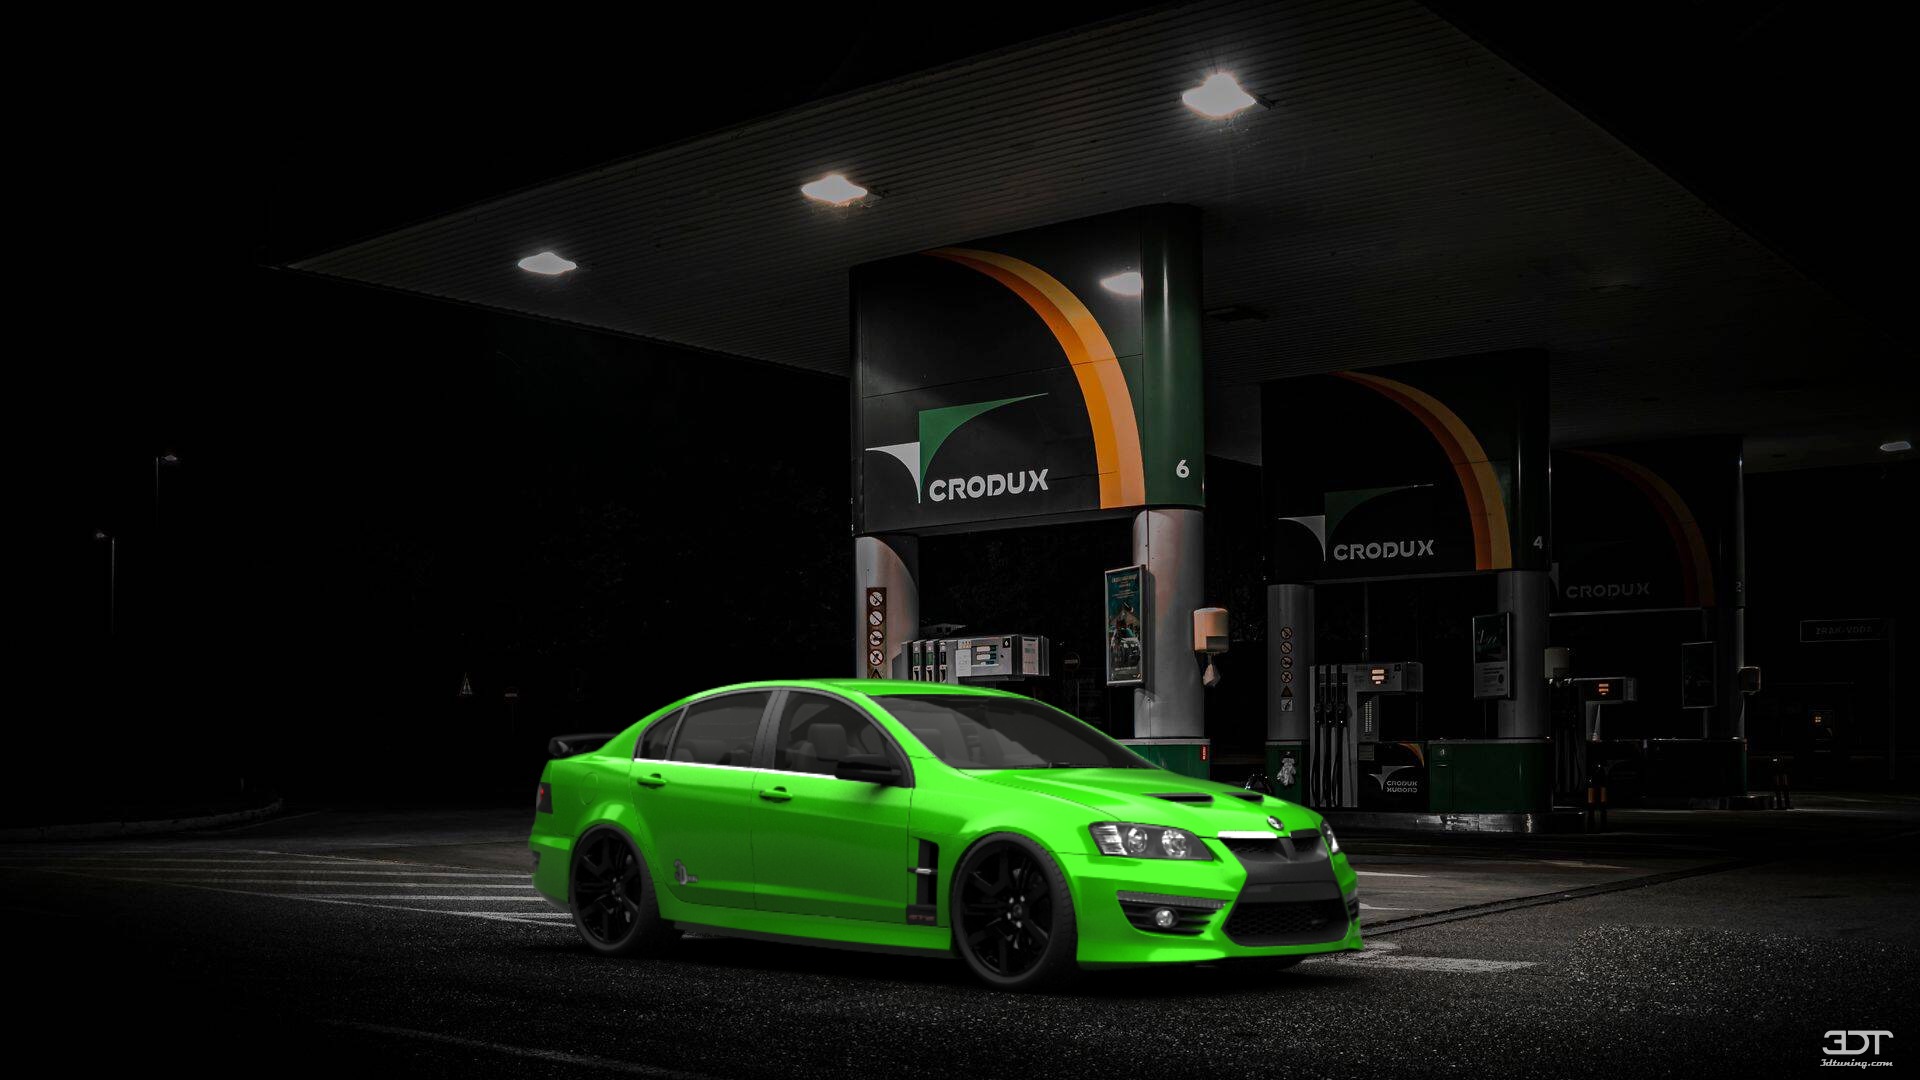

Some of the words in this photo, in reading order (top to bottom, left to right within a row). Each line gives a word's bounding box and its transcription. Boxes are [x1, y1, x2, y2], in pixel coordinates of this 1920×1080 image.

[1176, 459, 1190, 478] 6
[929, 469, 1049, 502] CRODUX
[1333, 539, 1434, 561] CRODUX
[1532, 535, 1544, 550] 4
[1565, 582, 1650, 599] CRODUX
